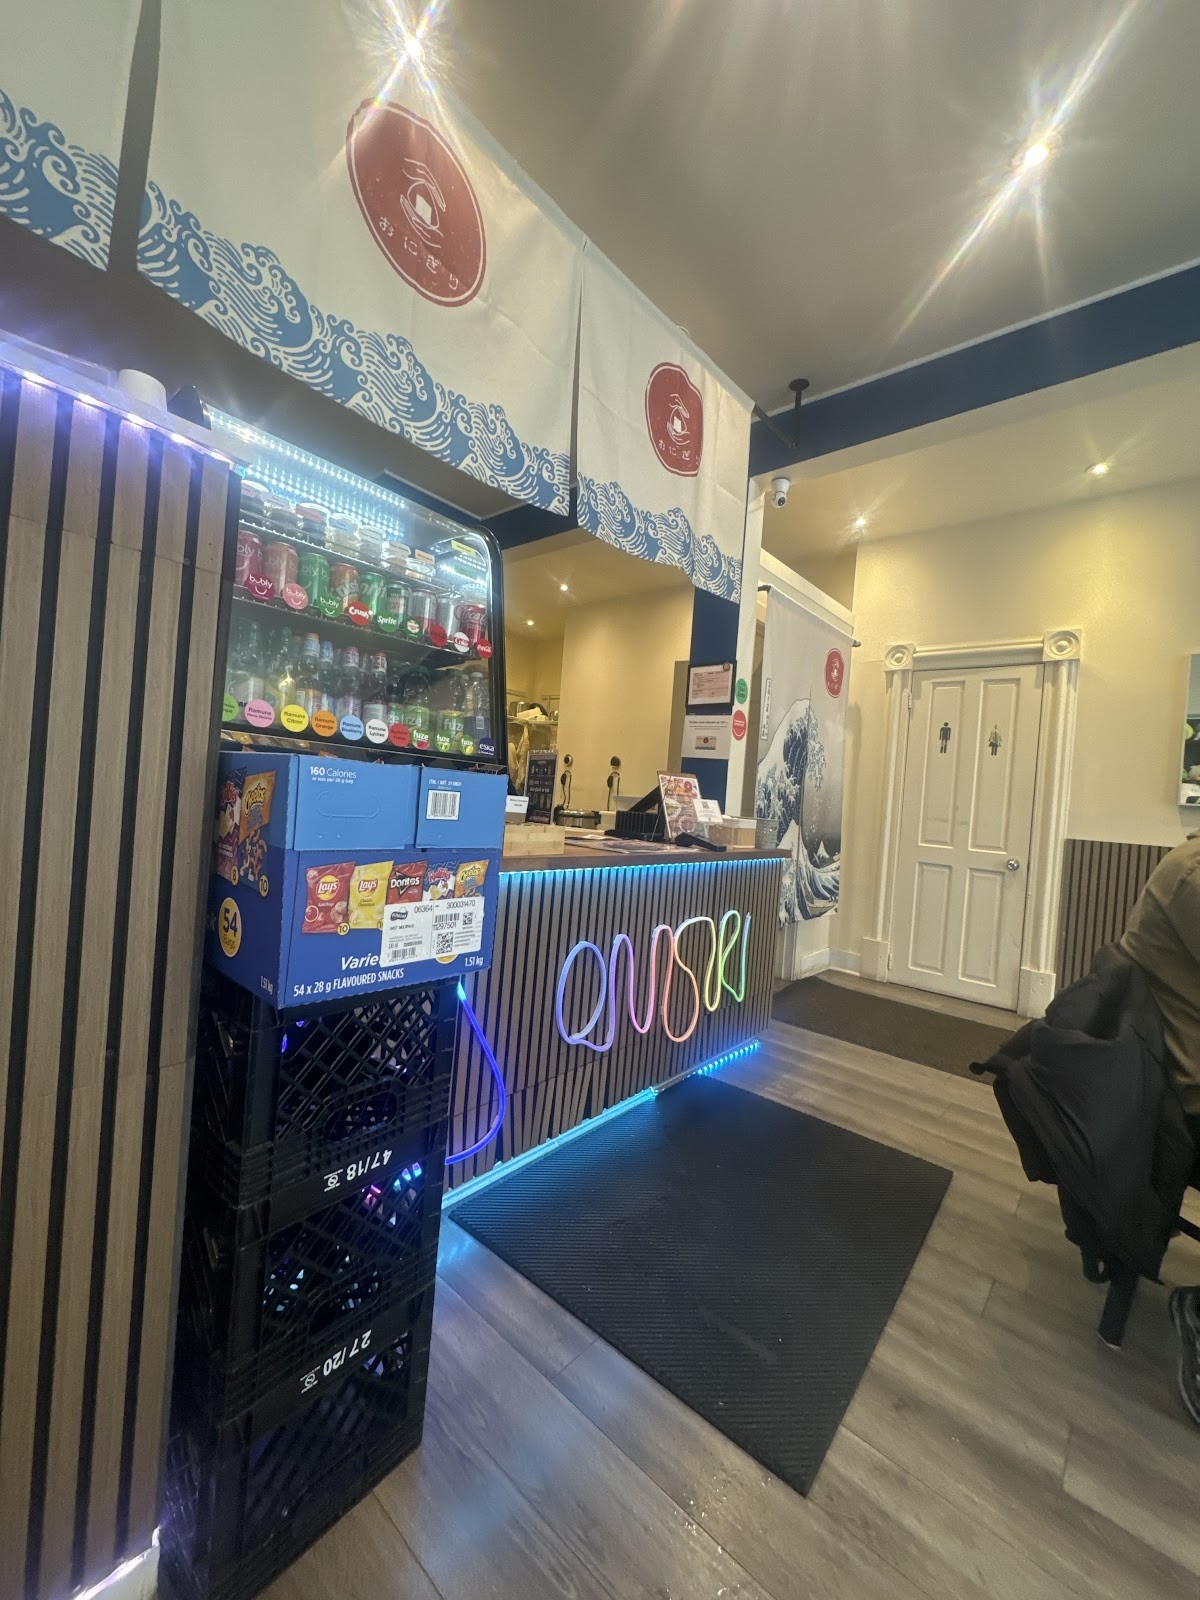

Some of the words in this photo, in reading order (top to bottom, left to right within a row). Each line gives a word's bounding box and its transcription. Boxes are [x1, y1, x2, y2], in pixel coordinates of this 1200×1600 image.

[249, 573, 273, 589] bubly
[286, 587, 306, 600] bubly
[320, 596, 340, 609] bubly
[348, 606, 370, 619] Crush
[377, 615, 397, 625] Sprite
[413, 730, 429, 741] fuze
[436, 734, 450, 743] fuze
[461, 738, 474, 746] fuze
[480, 743, 495, 752] eska
[310, 766, 326, 776] 160
[326, 767, 357, 779] Calories
[231, 869, 237, 882] 8
[260, 879, 268, 893] 10
[390, 877, 420, 888] Doritos
[223, 908, 238, 937] 54
[339, 924, 348, 933] 10
[341, 952, 381, 971] Varie
[464, 957, 475, 967] 1.51
[475, 956, 484, 966] kg
[293, 984, 304, 997] 54
[306, 985, 312, 994] x
[313, 981, 324, 993] 28
[325, 982, 332, 993] g
[333, 972, 377, 990] FLAVOURED
[378, 968, 405, 982] SNACKS
[346, 1149, 393, 1181] 47/18
